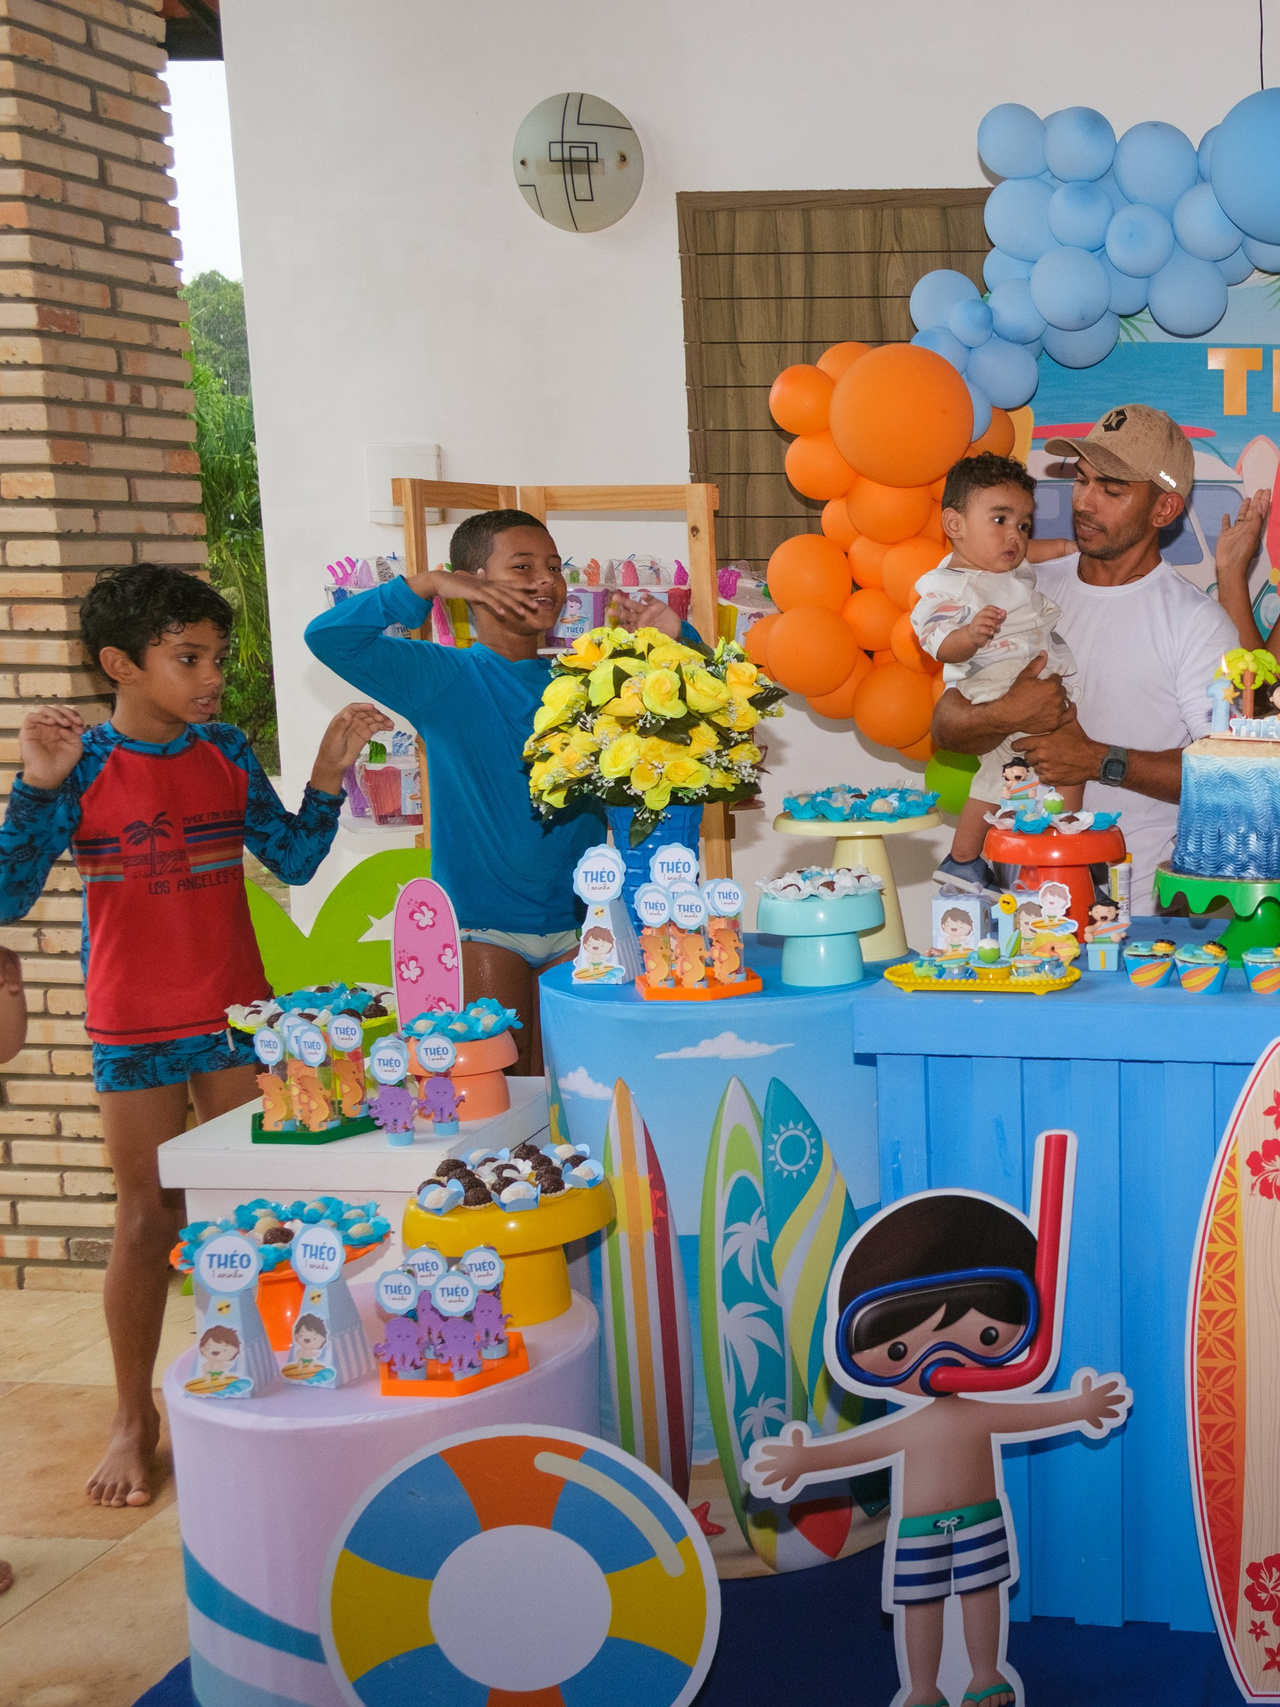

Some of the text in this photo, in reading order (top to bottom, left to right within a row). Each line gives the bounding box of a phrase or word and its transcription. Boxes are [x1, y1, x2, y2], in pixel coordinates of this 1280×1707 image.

[658, 858, 691, 873] THÉO
[148, 868, 241, 894] LOS ANGELES-C
[582, 867, 615, 883] THÉO
[717, 889, 739, 900] THÉO
[643, 900, 666, 911] THÉO
[676, 902, 701, 913] THÉO
[334, 1025, 356, 1036] THÉO
[259, 1038, 278, 1049] THÉO
[303, 1040, 321, 1050] THÉO
[423, 1045, 449, 1056] THÉO
[376, 1056, 401, 1068] THÉO
[301, 1241, 336, 1262] THÉO
[206, 1249, 251, 1269] THÉO
[468, 1259, 496, 1273] THÉO
[383, 1283, 411, 1295] THÉO
[439, 1284, 469, 1297] THÉO
